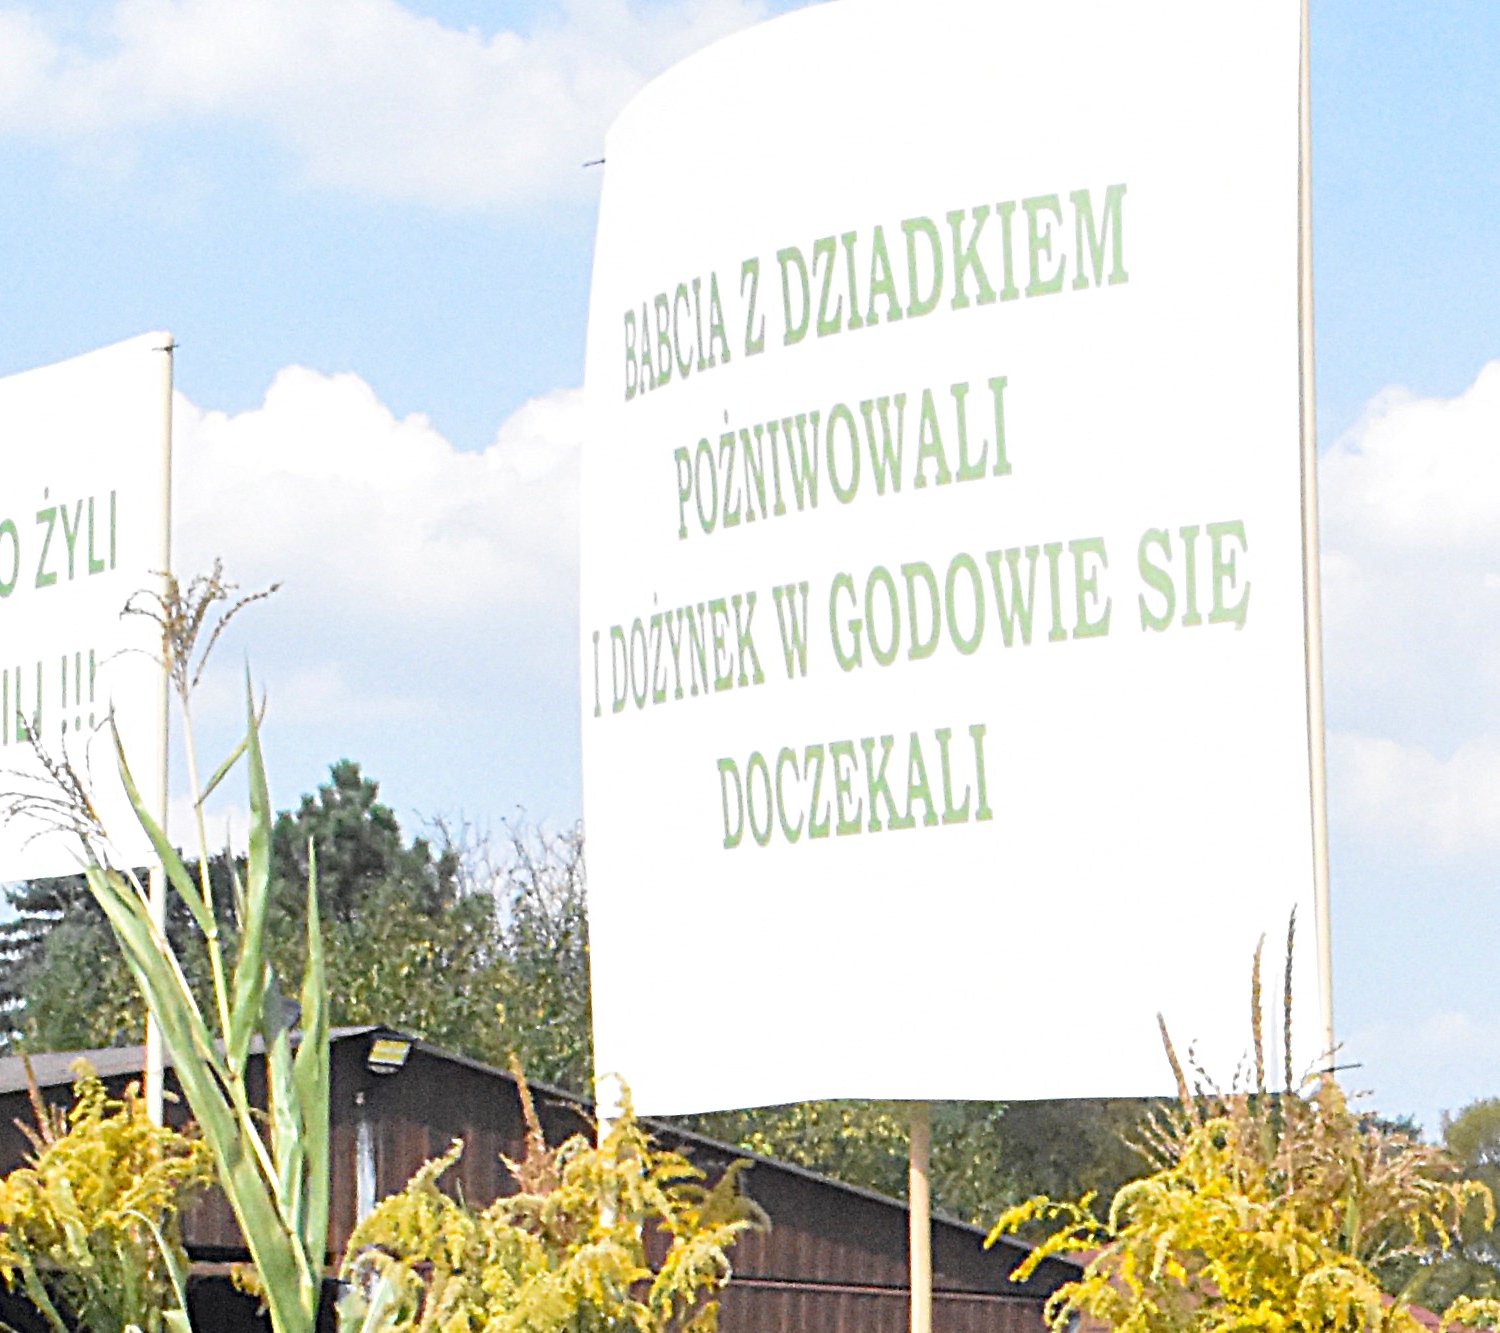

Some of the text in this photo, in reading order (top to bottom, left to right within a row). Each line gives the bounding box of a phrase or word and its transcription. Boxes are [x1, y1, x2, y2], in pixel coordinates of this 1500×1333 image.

[624, 184, 1128, 401] BABCIA Z DZIADKIEM
[35, 487, 116, 589] ŻYLI
[593, 520, 1250, 717] I DOŻYNEK W GODOWIE SIĘ
[717, 724, 993, 849] DOCZEKALI
